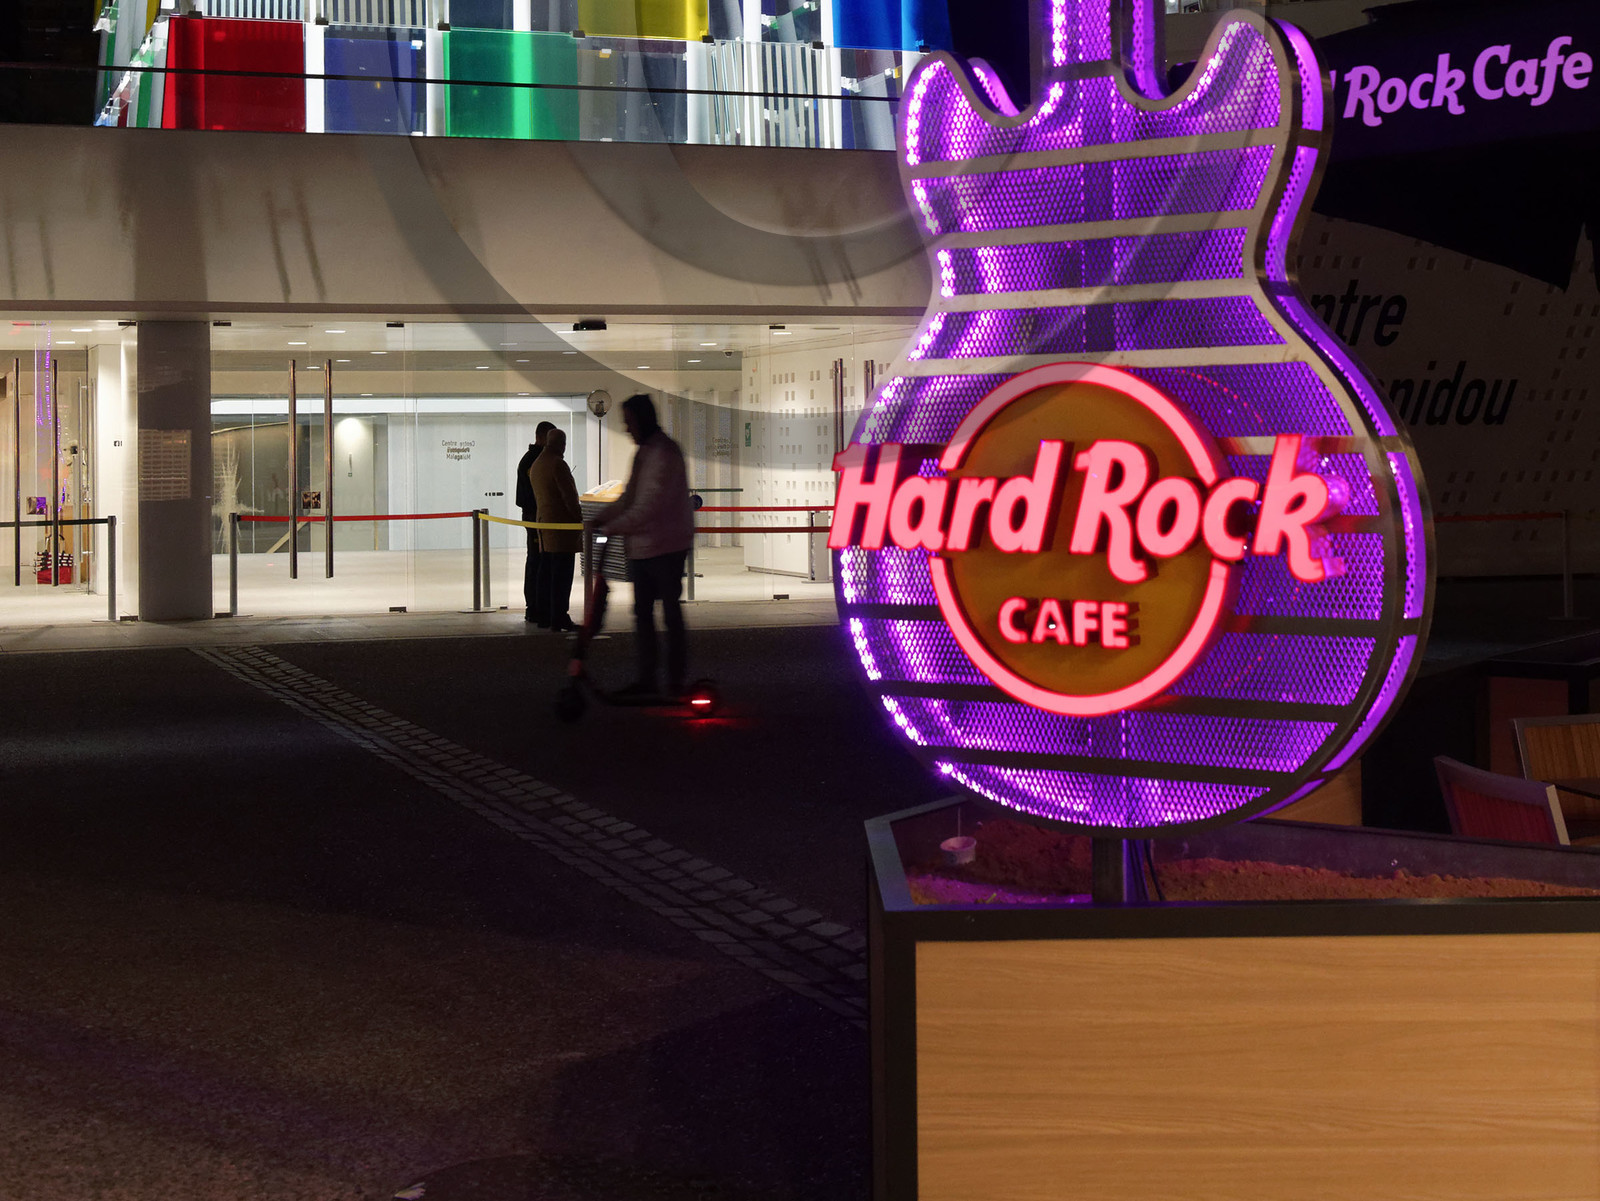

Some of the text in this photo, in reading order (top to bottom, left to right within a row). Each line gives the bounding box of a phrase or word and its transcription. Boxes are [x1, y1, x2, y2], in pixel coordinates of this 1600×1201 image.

[1343, 35, 1593, 127] Rock Cafe
[1310, 279, 1407, 347] ntre
[828, 433, 1330, 584] Hard Rock
[999, 597, 1130, 650] CAFE
